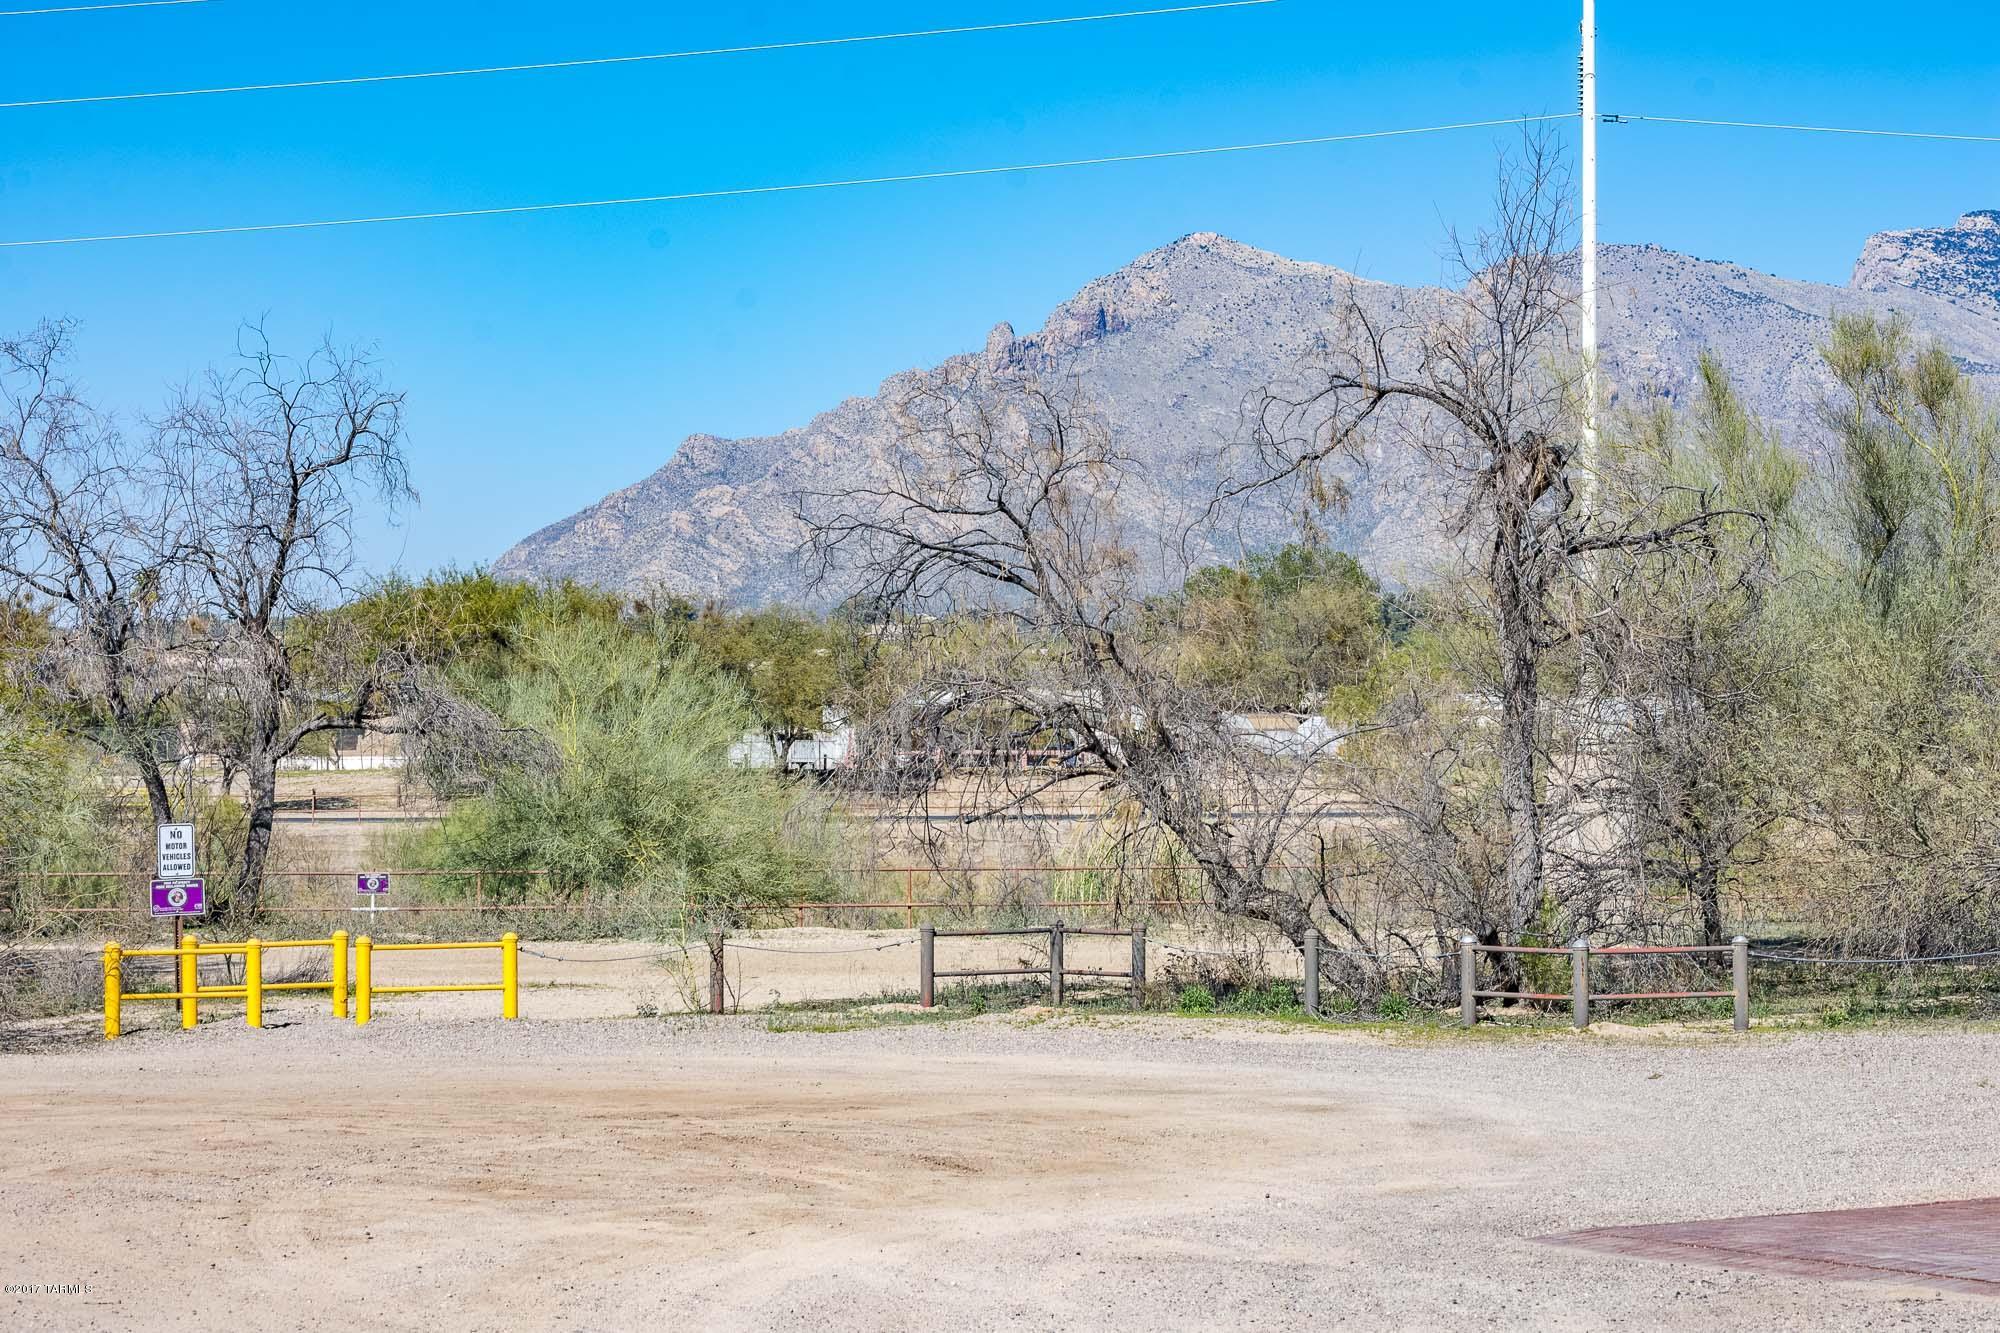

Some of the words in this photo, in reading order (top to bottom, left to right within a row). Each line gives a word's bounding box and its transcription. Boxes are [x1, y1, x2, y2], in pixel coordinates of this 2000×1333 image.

[170, 830, 183, 839] NO
[165, 842, 188, 850] MOTOR
[162, 853, 192, 861] VEHICLES
[162, 863, 191, 871] ALLOWED
